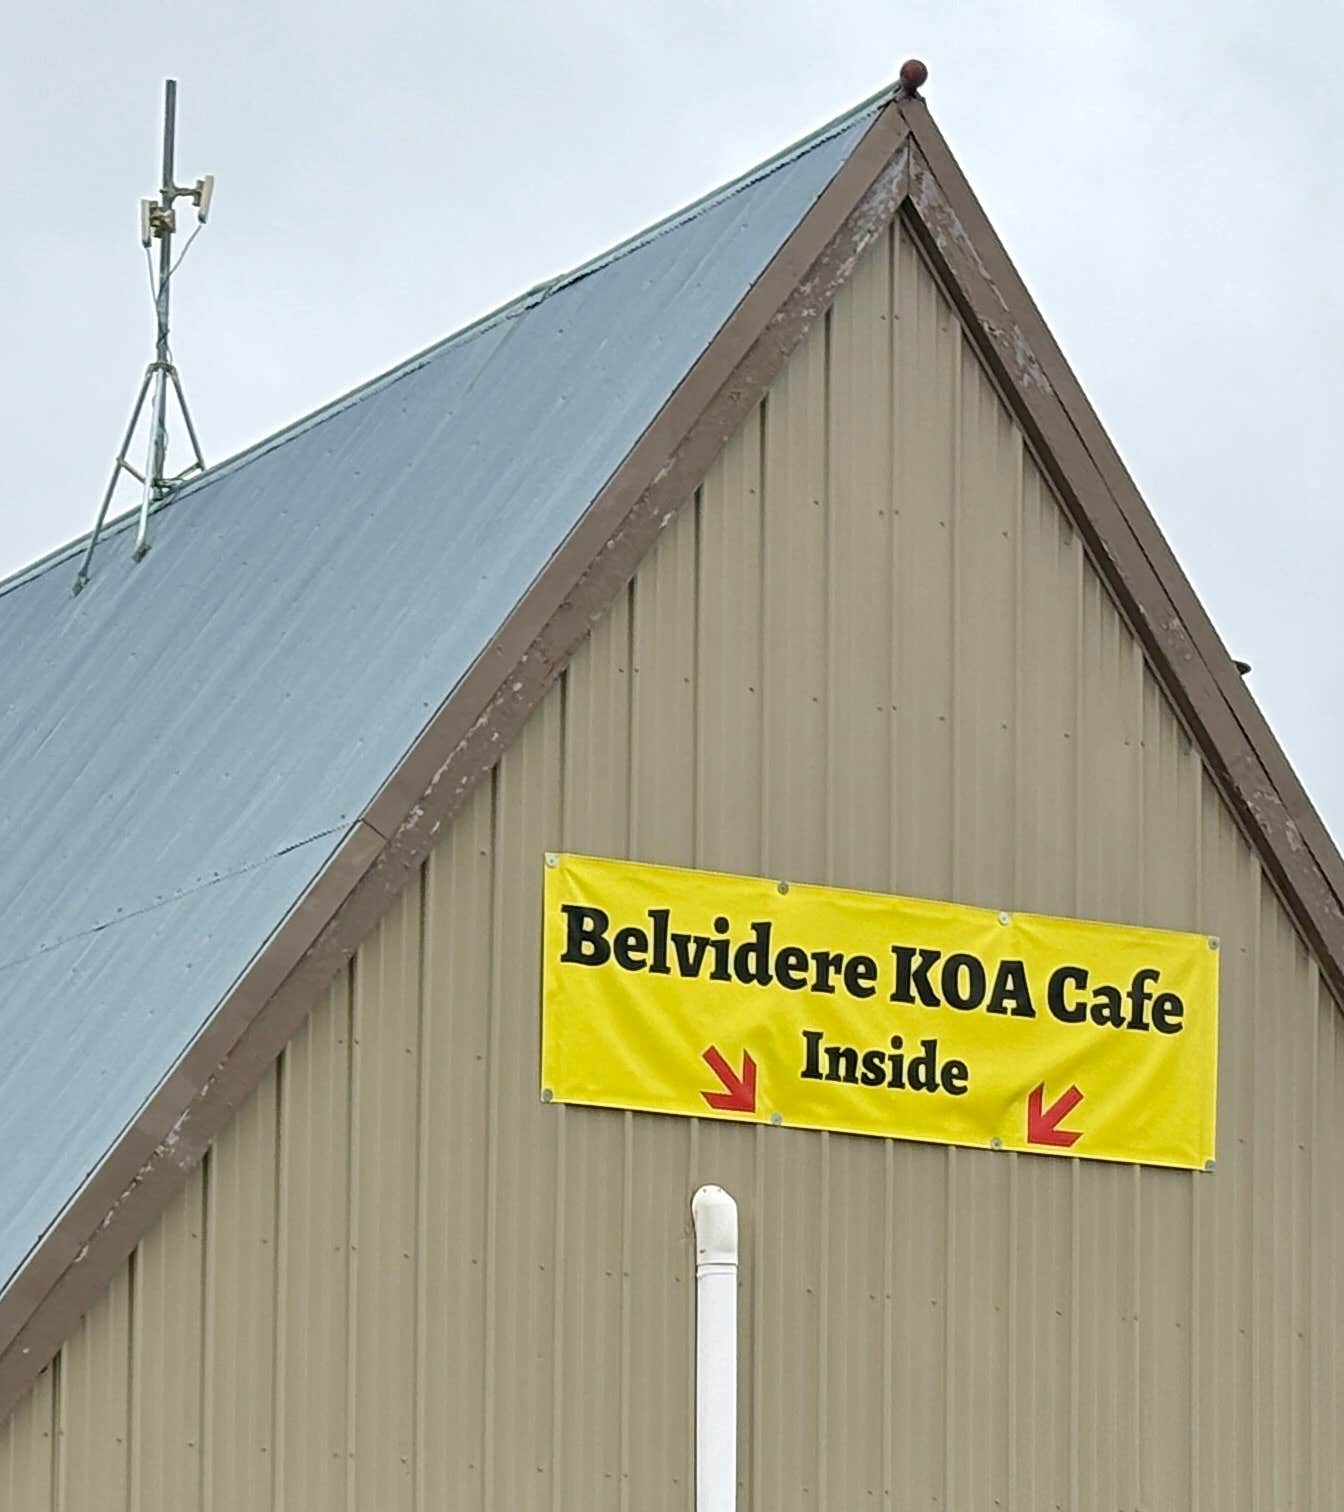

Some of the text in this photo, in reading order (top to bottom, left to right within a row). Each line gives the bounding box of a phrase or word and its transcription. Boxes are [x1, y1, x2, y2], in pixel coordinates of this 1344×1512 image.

[560, 904, 1185, 1034] Belvidere KOA Cafe
[802, 1031, 969, 1095] Inside
